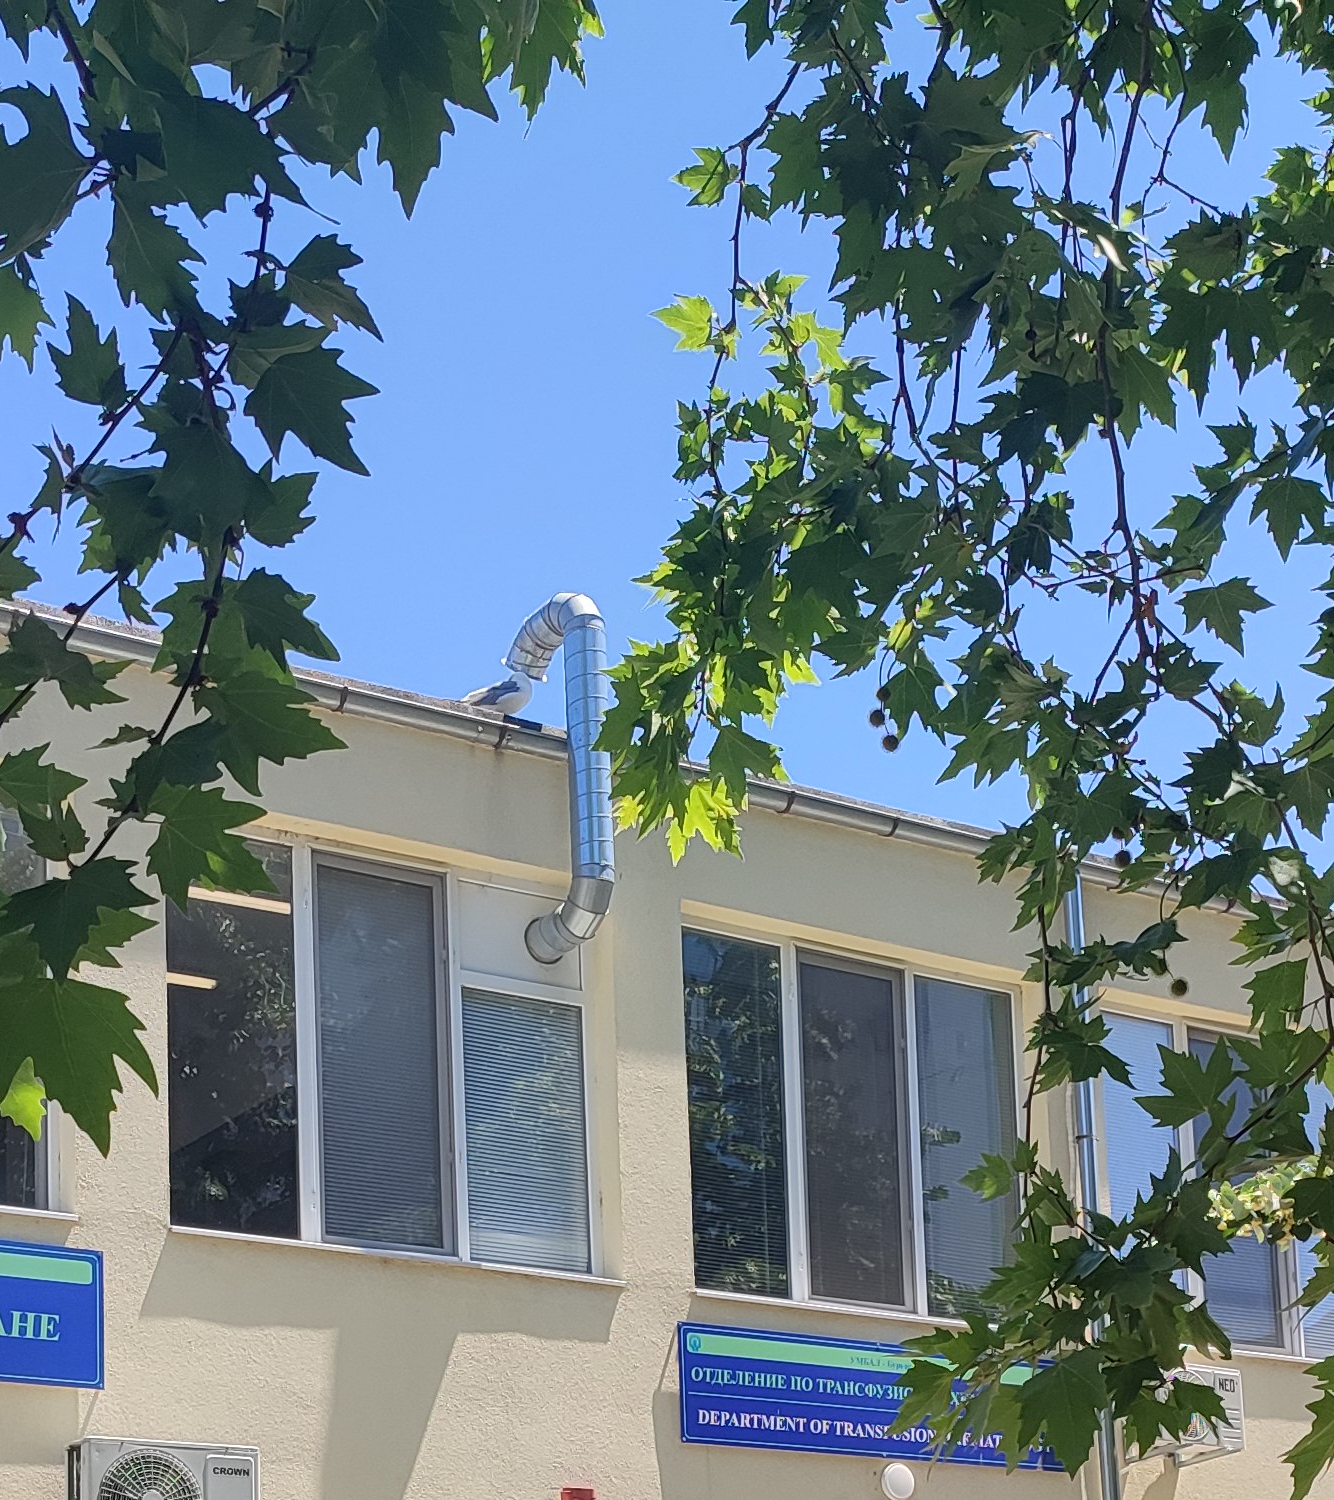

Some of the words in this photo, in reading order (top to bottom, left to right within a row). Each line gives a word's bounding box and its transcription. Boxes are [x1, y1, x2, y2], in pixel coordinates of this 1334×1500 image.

[690, 1366, 787, 1388] ОТДЕЛЕНИЕ
[790, 1375, 814, 1392] ПО
[1218, 1377, 1236, 1393] NEO
[697, 1408, 807, 1433] DEPARTMENT
[809, 1419, 833, 1435] OF
[212, 1466, 250, 1477] CROWN
